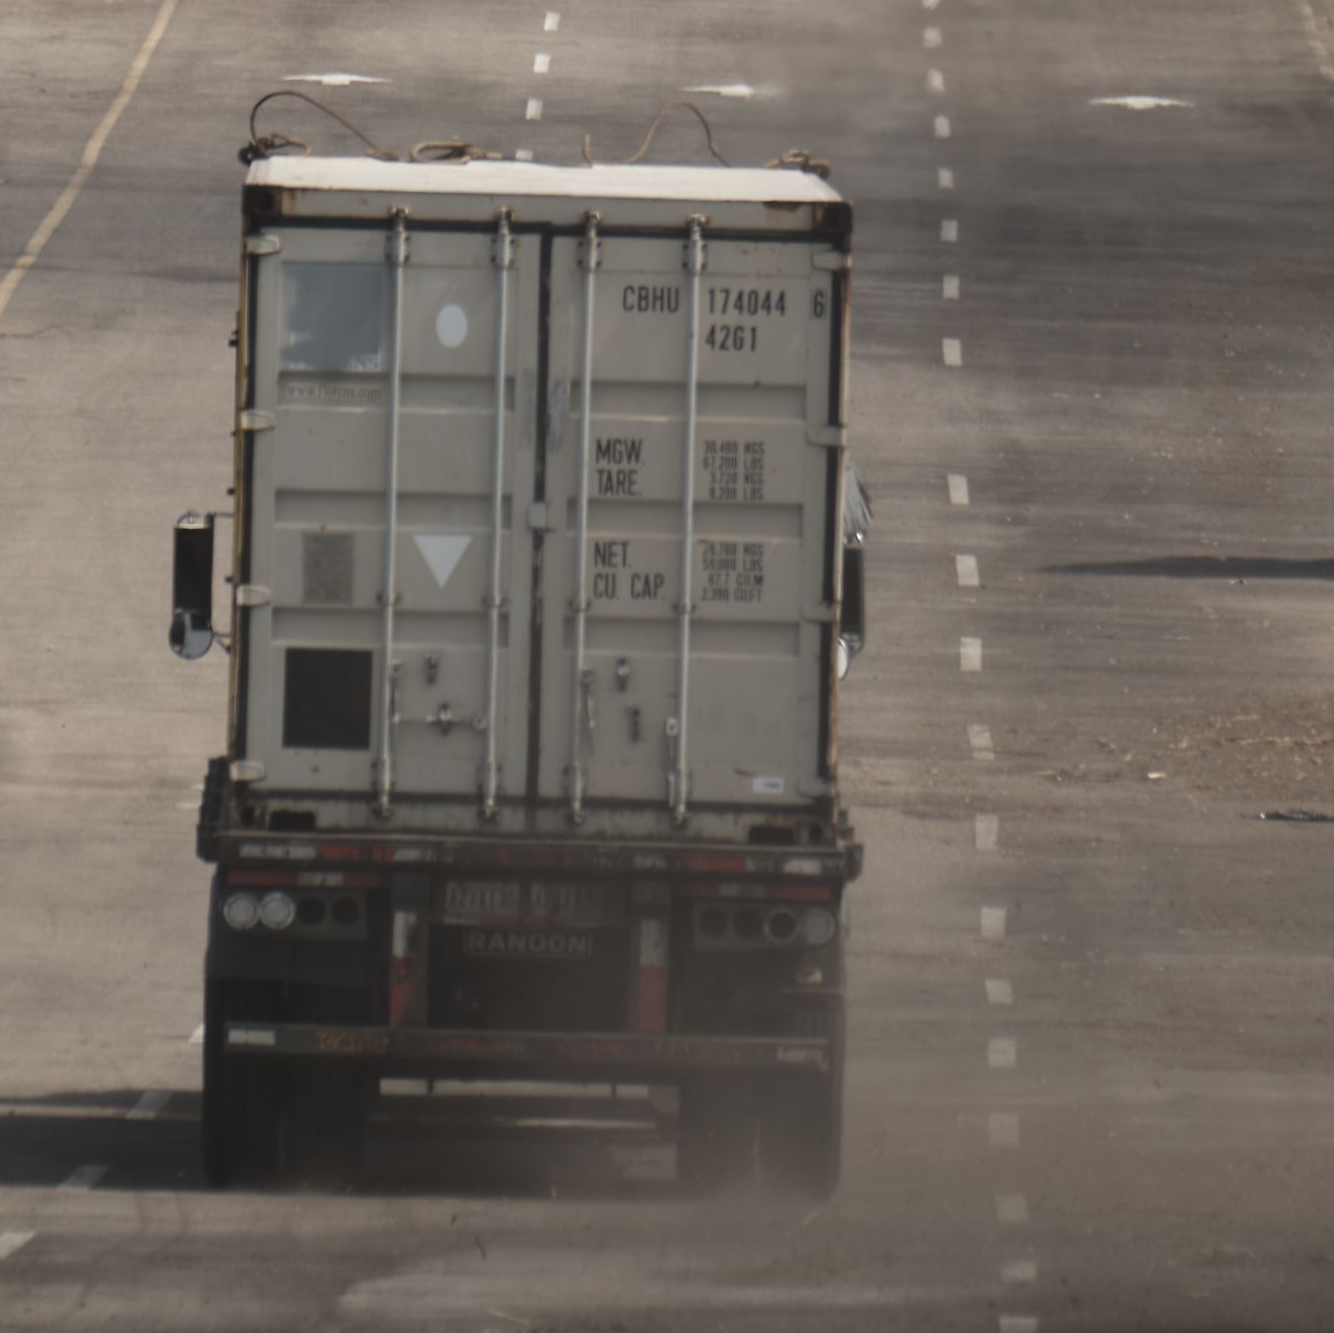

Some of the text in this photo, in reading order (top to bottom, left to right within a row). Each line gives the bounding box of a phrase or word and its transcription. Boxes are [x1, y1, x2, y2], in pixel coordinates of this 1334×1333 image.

[622, 285, 680, 314] CBHU
[708, 288, 786, 317] 174044
[743, 457, 764, 471] LBS
[742, 487, 764, 501] LBS
[742, 558, 763, 573] LBS
[468, 933, 587, 955] RANDON
